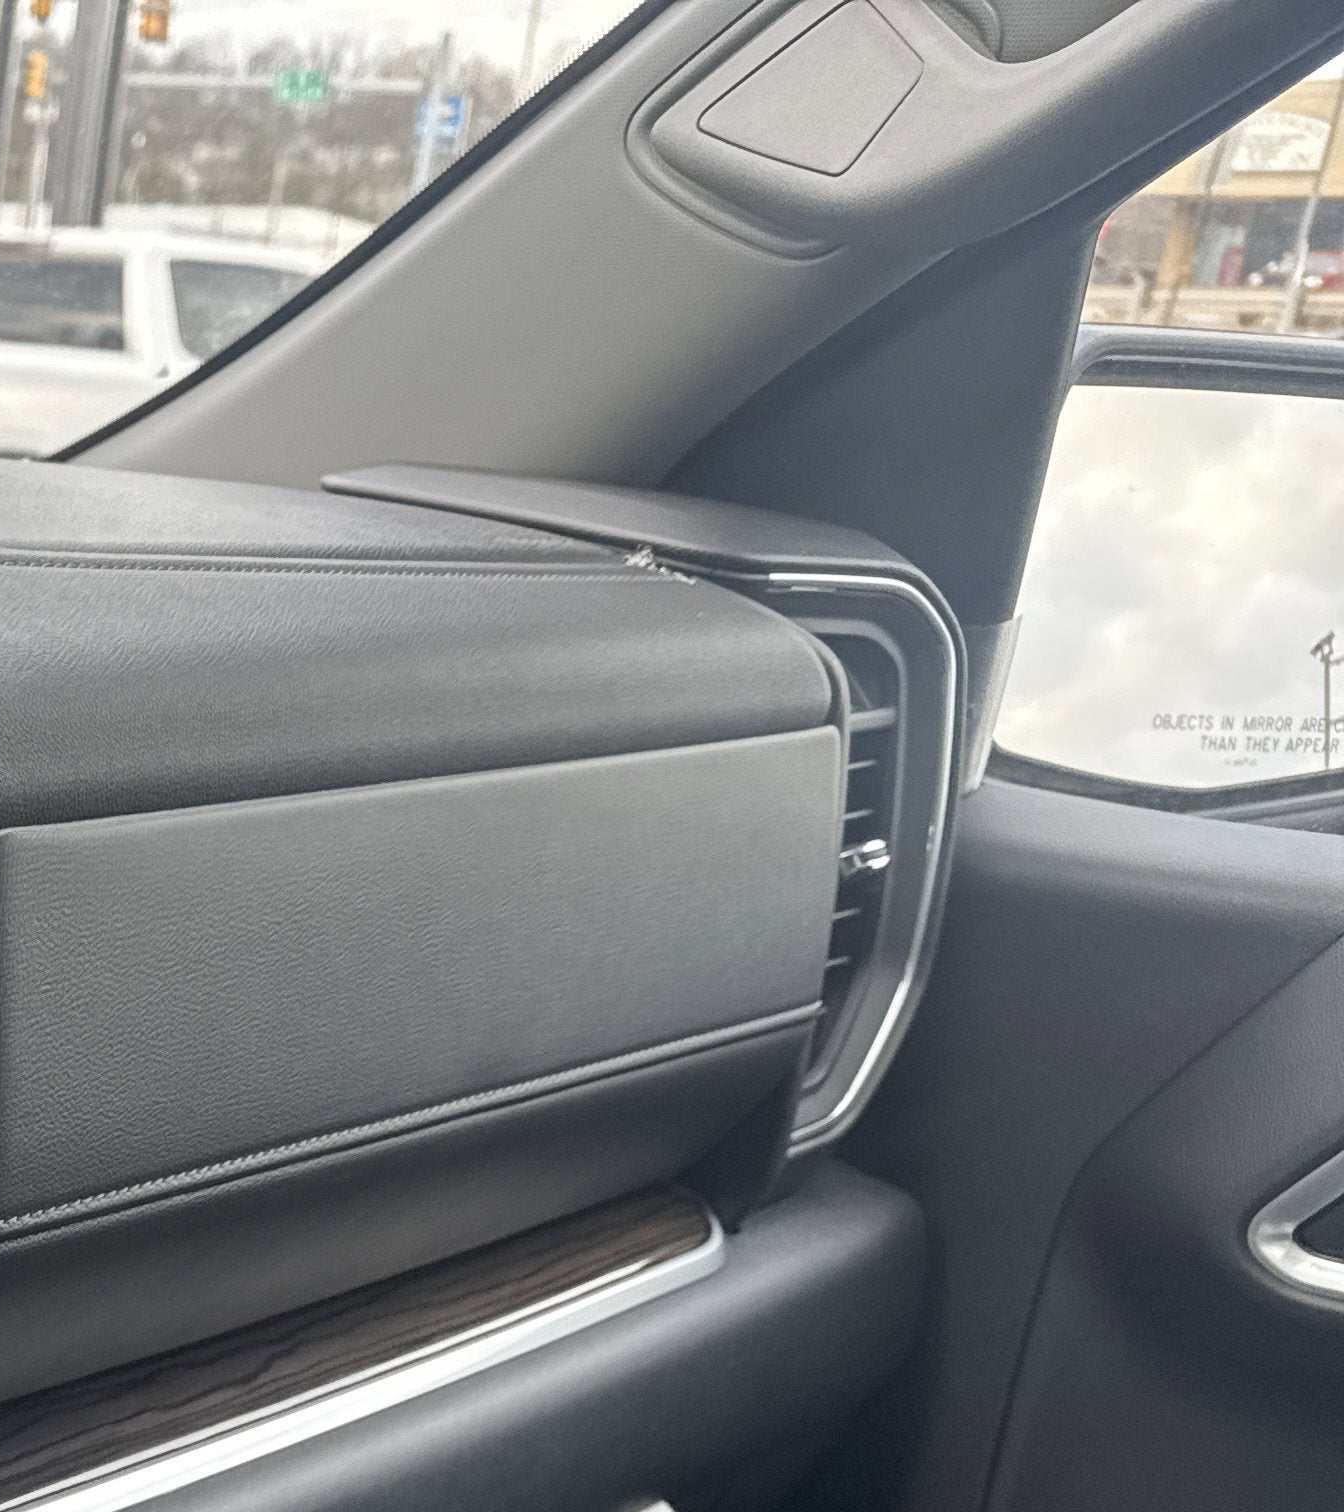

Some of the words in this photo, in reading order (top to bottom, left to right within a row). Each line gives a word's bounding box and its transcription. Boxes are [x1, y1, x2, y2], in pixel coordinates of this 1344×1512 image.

[1152, 713, 1214, 731] OBJECTS
[1220, 715, 1234, 731] IN
[1243, 715, 1293, 732] MIRROR
[1300, 717, 1326, 733] ARE
[1200, 735, 1237, 751] THAN
[1246, 736, 1280, 752] THEY
[1285, 737, 1340, 754] APPEAR
